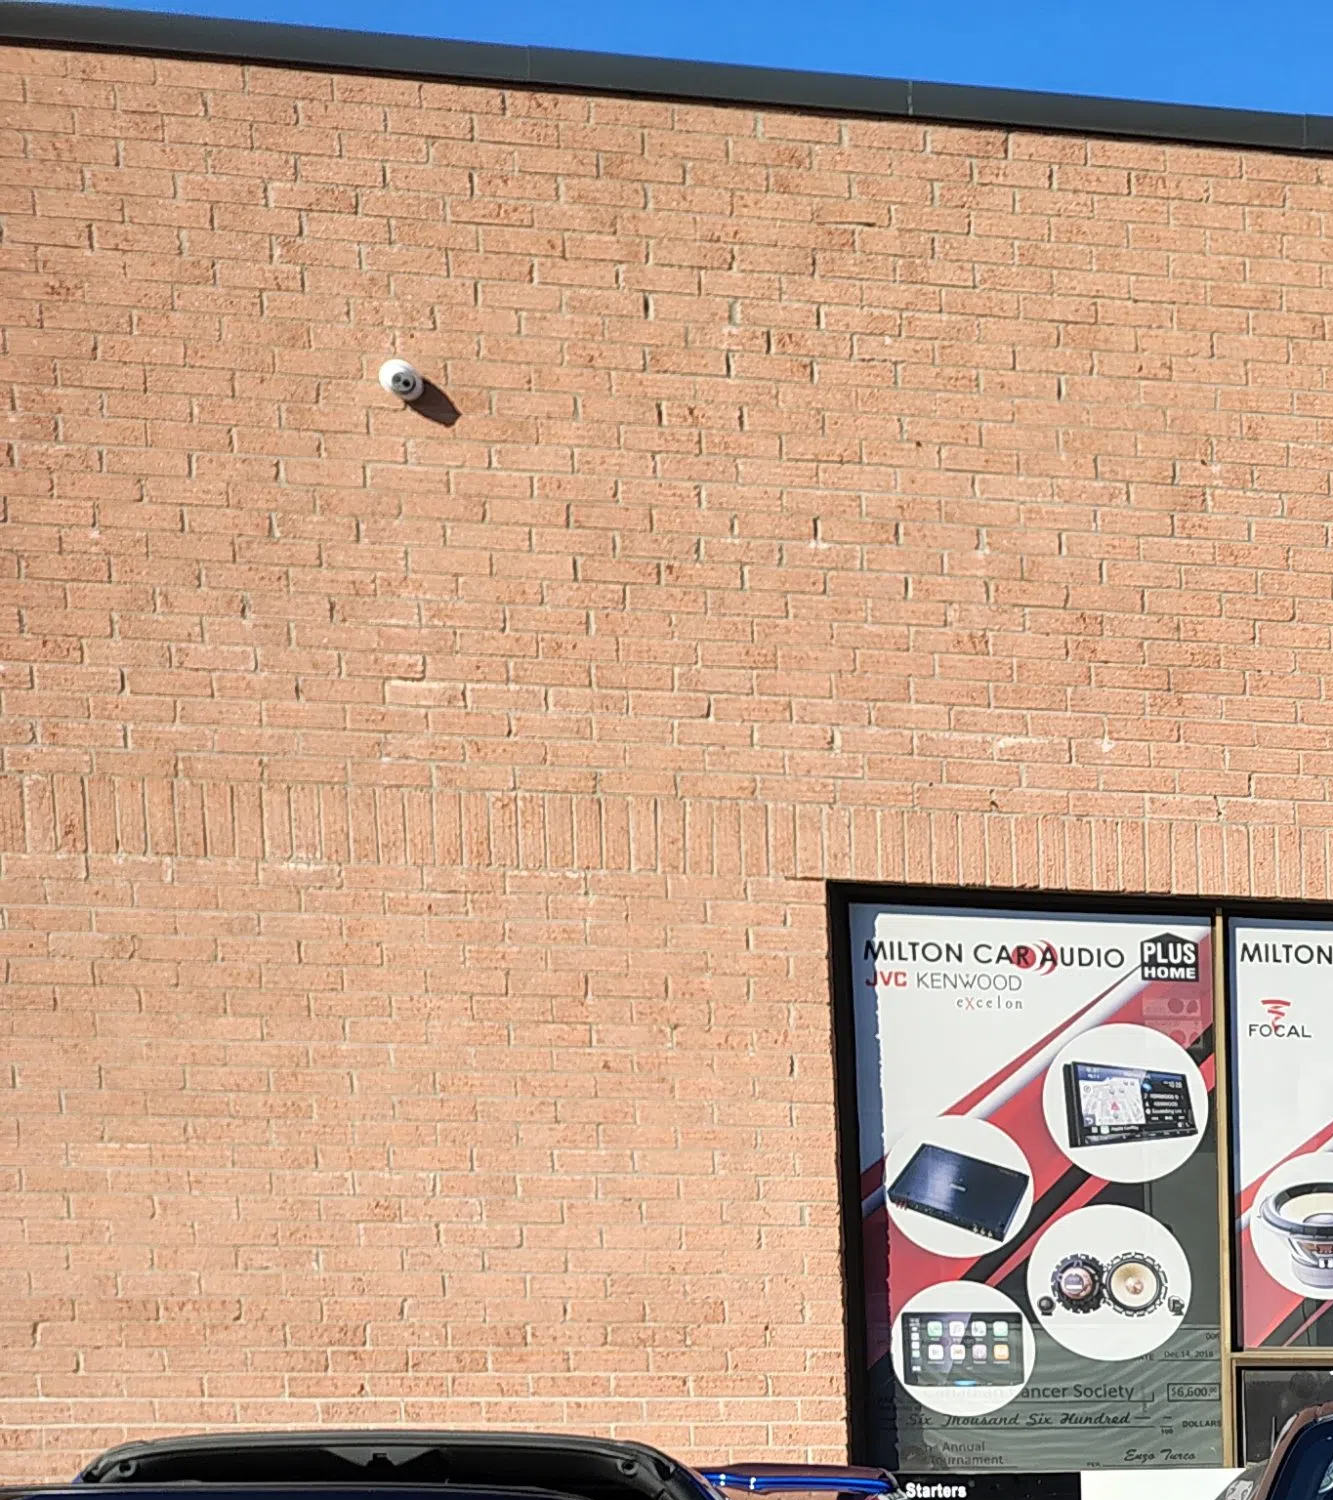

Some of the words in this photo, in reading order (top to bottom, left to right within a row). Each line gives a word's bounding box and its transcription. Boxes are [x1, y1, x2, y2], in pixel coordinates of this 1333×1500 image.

[863, 940, 963, 963] MILTON
[973, 943, 1031, 966] CAR
[1039, 944, 1125, 969] AUDIO
[1142, 941, 1196, 965] PLUS
[1240, 942, 1333, 966] MILTON
[865, 969, 908, 987] JVC
[916, 971, 1023, 991] KENWOOD
[1143, 966, 1196, 979] HOME
[1248, 1023, 1312, 1038] FOCAL
[1019, 1386, 1069, 1399] ancer
[1073, 1384, 1135, 1400] Society
[907, 1413, 932, 1426] Six
[941, 1413, 1020, 1427] Thousand
[1025, 1413, 1053, 1426] Six
[1059, 1412, 1131, 1425] Hundred
[1182, 1420, 1221, 1428] DOLLARS
[941, 1440, 985, 1452] Annual
[1159, 1448, 1197, 1461] Turco
[905, 1482, 968, 1499] Starters
